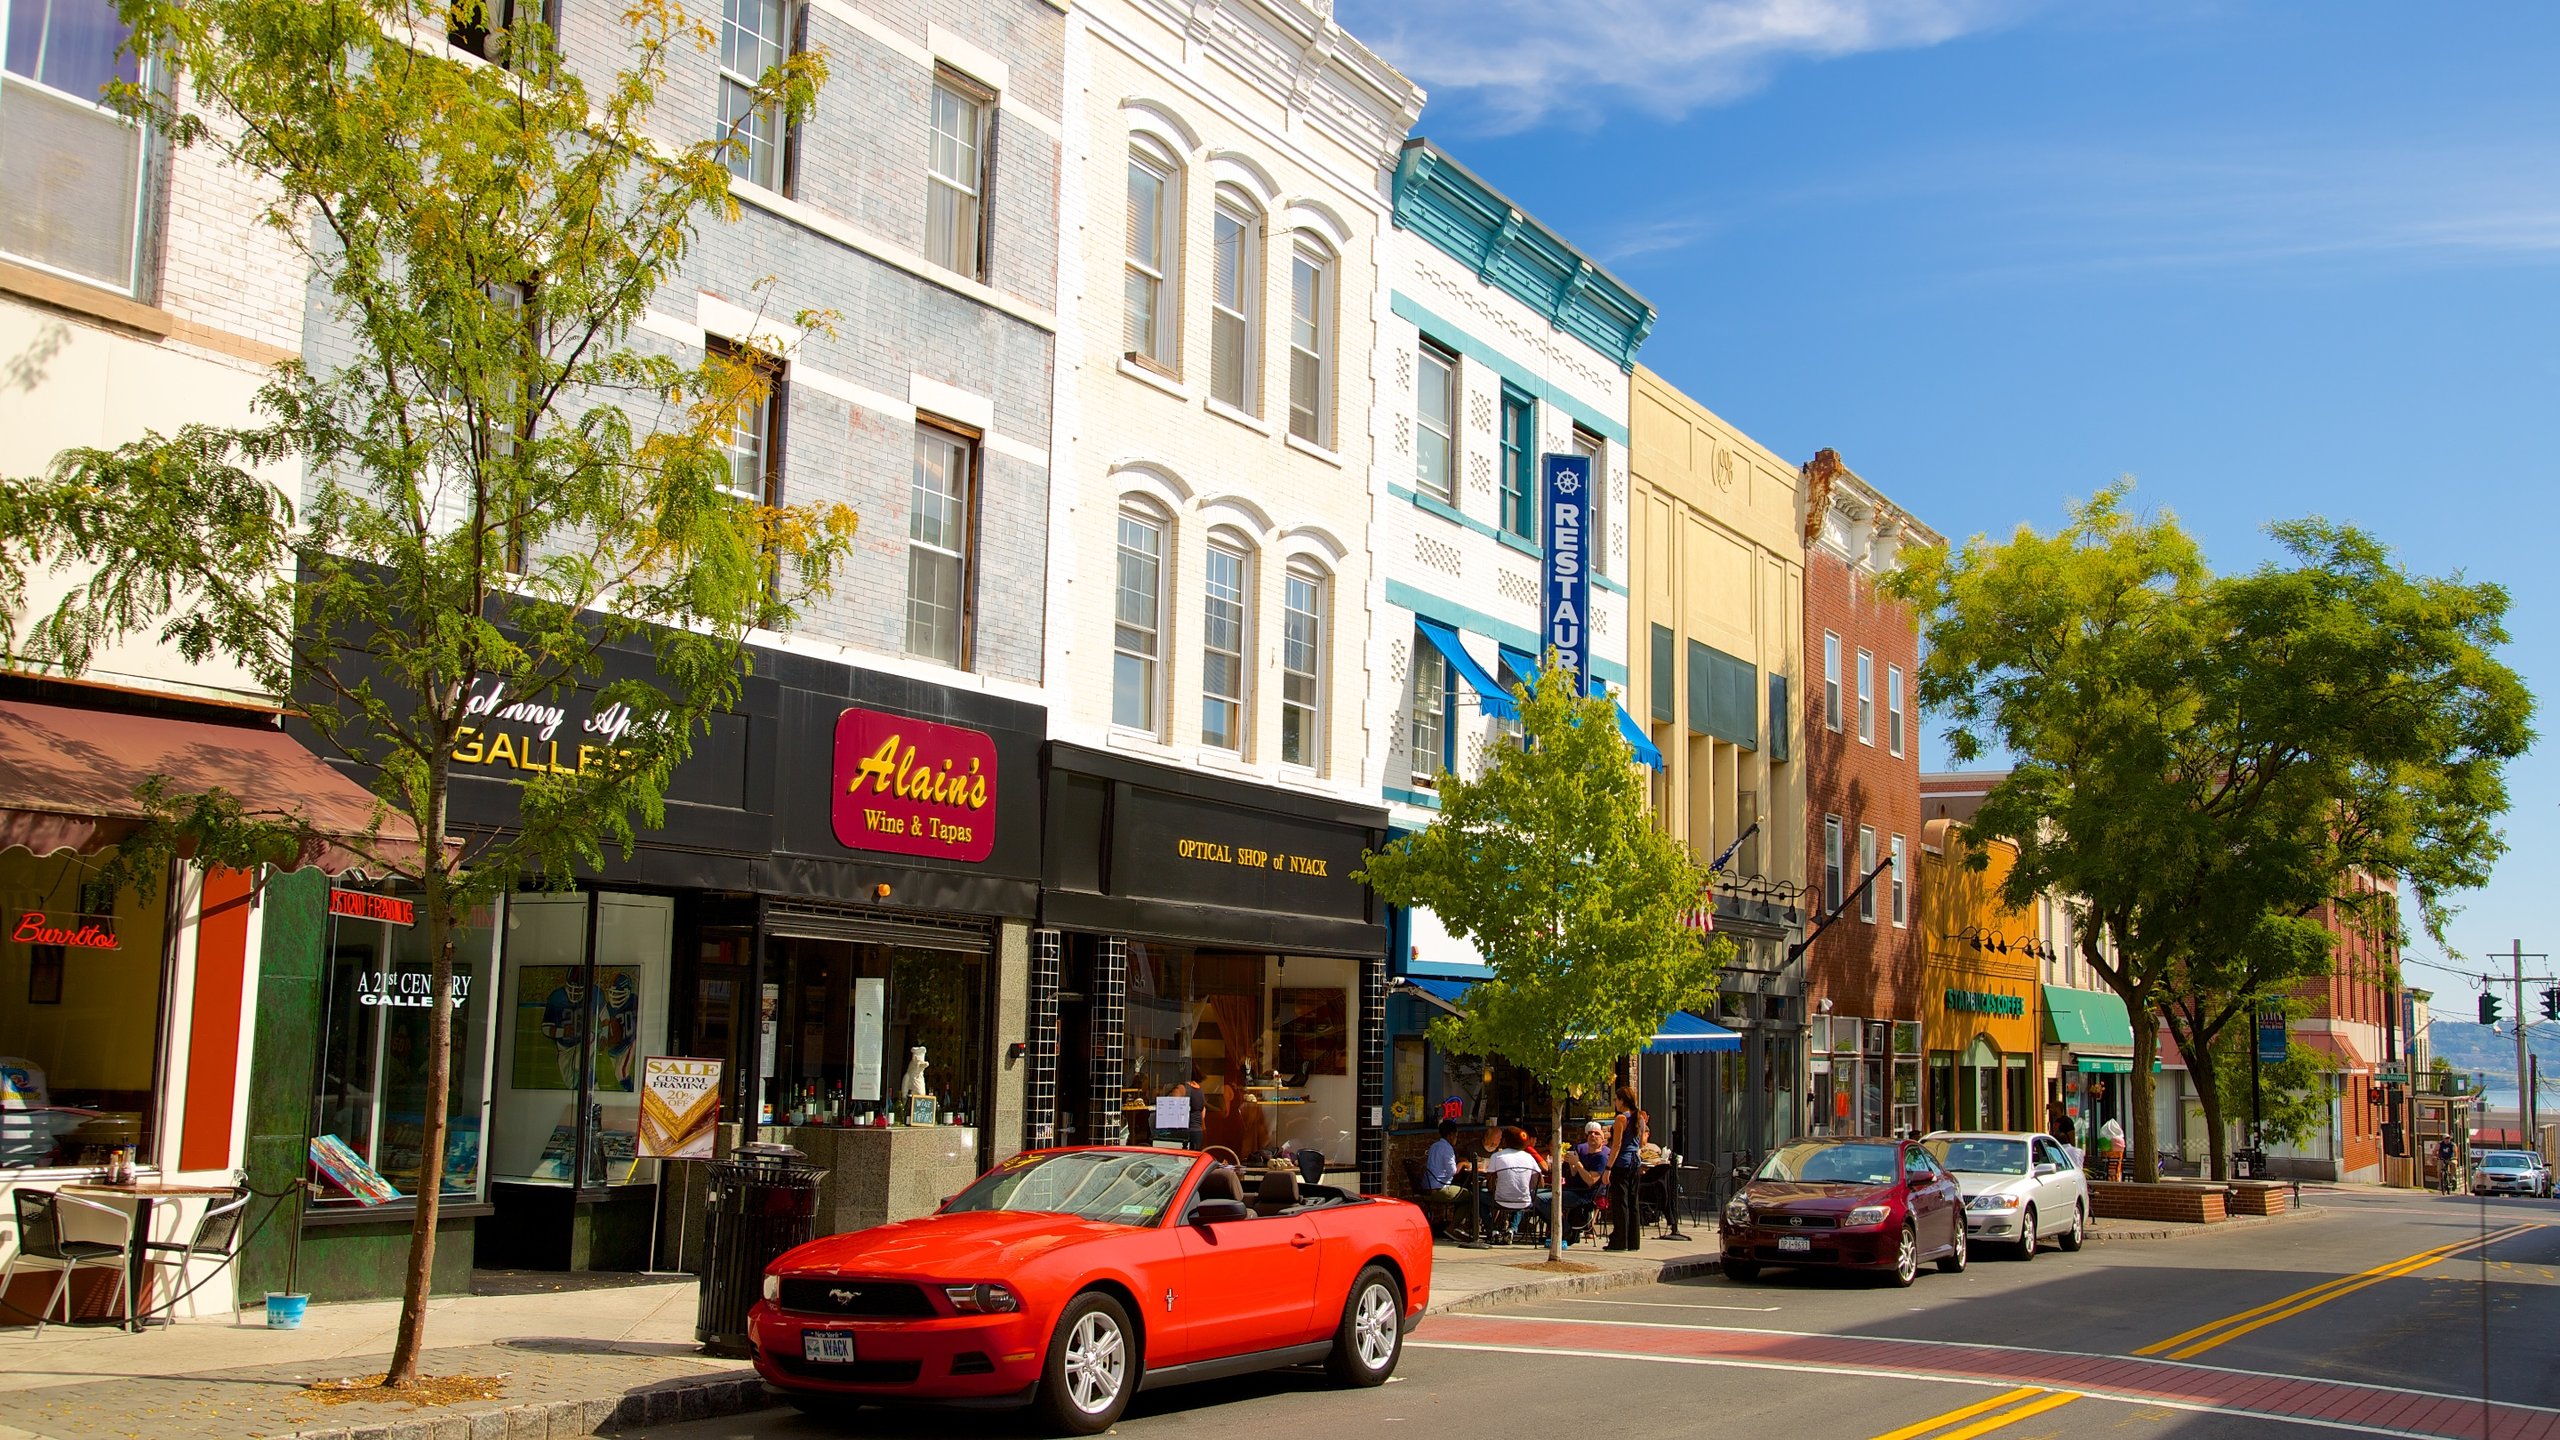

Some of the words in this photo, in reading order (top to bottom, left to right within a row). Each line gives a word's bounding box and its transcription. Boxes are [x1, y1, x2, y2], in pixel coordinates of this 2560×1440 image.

[1553, 502, 1583, 697] RESTAUR
[848, 734, 988, 809] Alain's
[864, 808, 904, 834] Wine
[911, 815, 923, 837] &
[929, 817, 972, 844] Tapas
[1179, 839, 1232, 863] OPTICAL
[1238, 847, 1268, 868] SHOP
[1273, 854, 1285, 870] of
[1289, 855, 1328, 877] NYACK
[13, 911, 118, 948] Burritos
[357, 971, 369, 993] A
[373, 971, 398, 993] 21st
[401, 972, 473, 996] CENRY
[360, 994, 466, 1008] GALLEY
[1946, 988, 1996, 1013] STARBUCKS
[1997, 994, 2025, 1016] COFFEE
[647, 1060, 719, 1077] SALE
[656, 1075, 706, 1084] CUSTOM
[652, 1081, 708, 1090] FRAMING
[667, 1090, 695, 1101] 20%
[823, 1340, 849, 1356] NYACK
